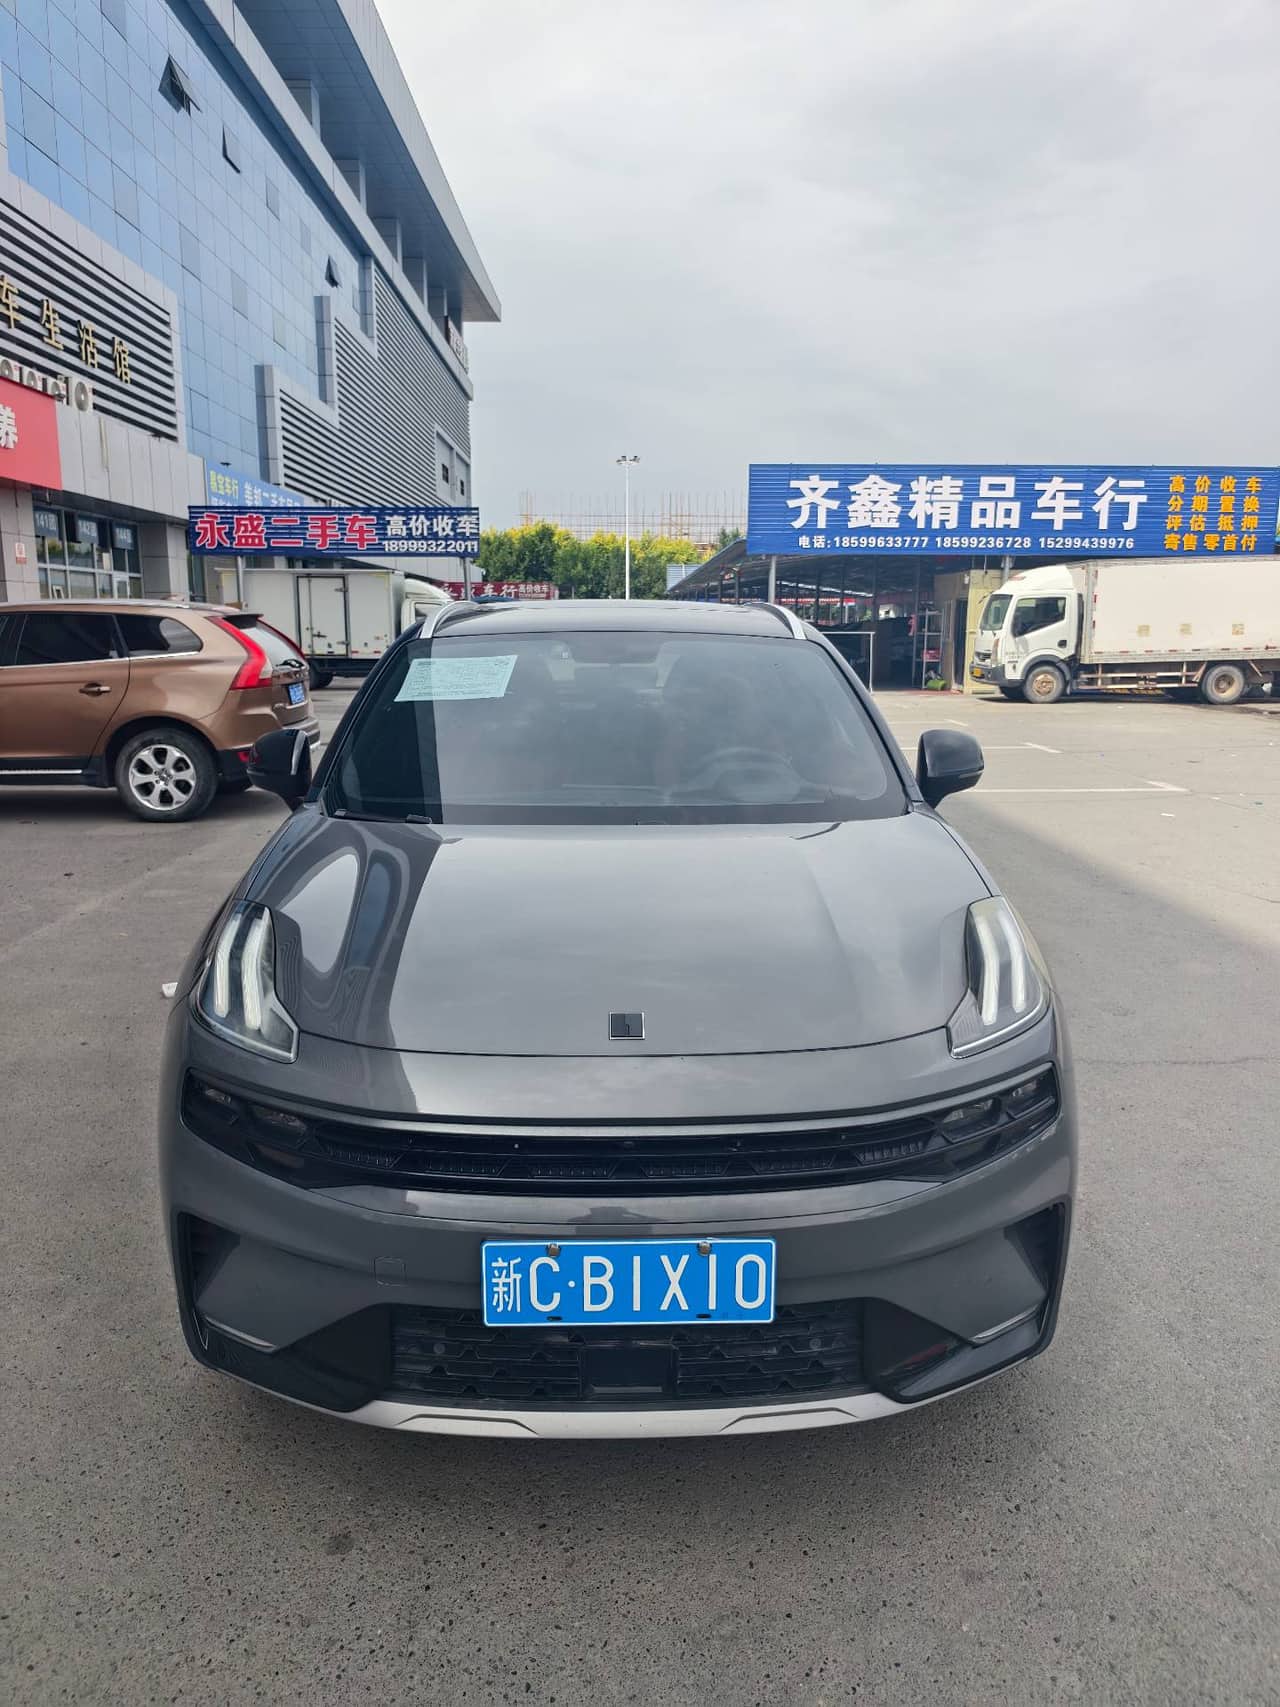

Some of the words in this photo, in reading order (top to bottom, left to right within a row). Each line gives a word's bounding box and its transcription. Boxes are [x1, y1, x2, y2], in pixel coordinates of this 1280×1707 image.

[0, 274, 132, 385] 车生活馆
[1168, 474, 1262, 494] 高价收车
[788, 474, 1149, 530] 齐鑫精品车行
[1167, 494, 1260, 513] 分期置换
[195, 513, 379, 550] 永盛二手车
[385, 514, 478, 537] 高价收车
[1165, 514, 1259, 532] 评估抵押
[382, 540, 478, 552] 18999322011
[935, 536, 1031, 549] 18599236728
[1038, 537, 1135, 549] 15299439976
